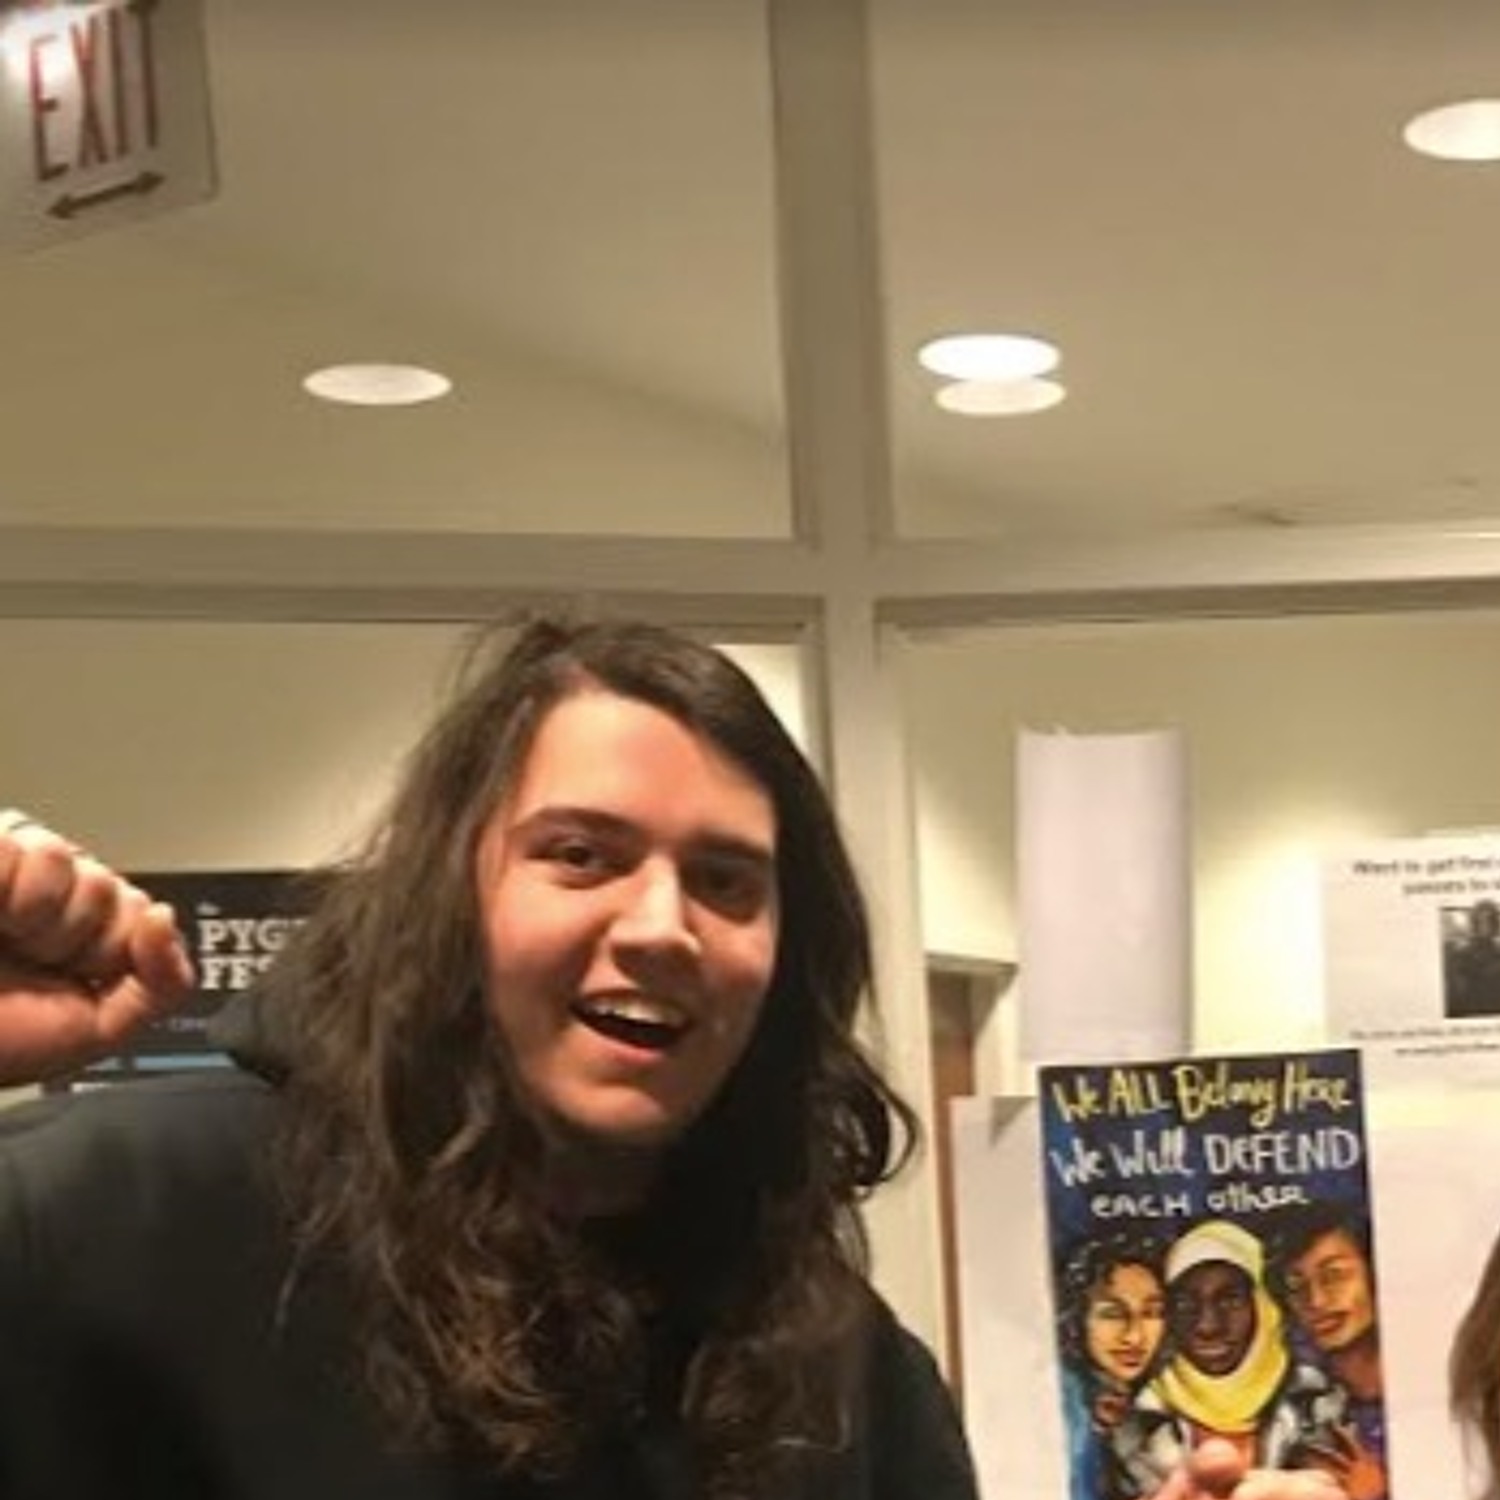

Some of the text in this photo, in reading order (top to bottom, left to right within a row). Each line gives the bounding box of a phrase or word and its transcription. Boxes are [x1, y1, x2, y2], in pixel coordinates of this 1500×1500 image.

[30, 0, 159, 181] EXIT
[198, 918, 308, 952] PYG
[1051, 1074, 1102, 1123] We
[1107, 1068, 1174, 1115] ALL
[1173, 1061, 1279, 1129] Belong
[1050, 1137, 1105, 1188] We
